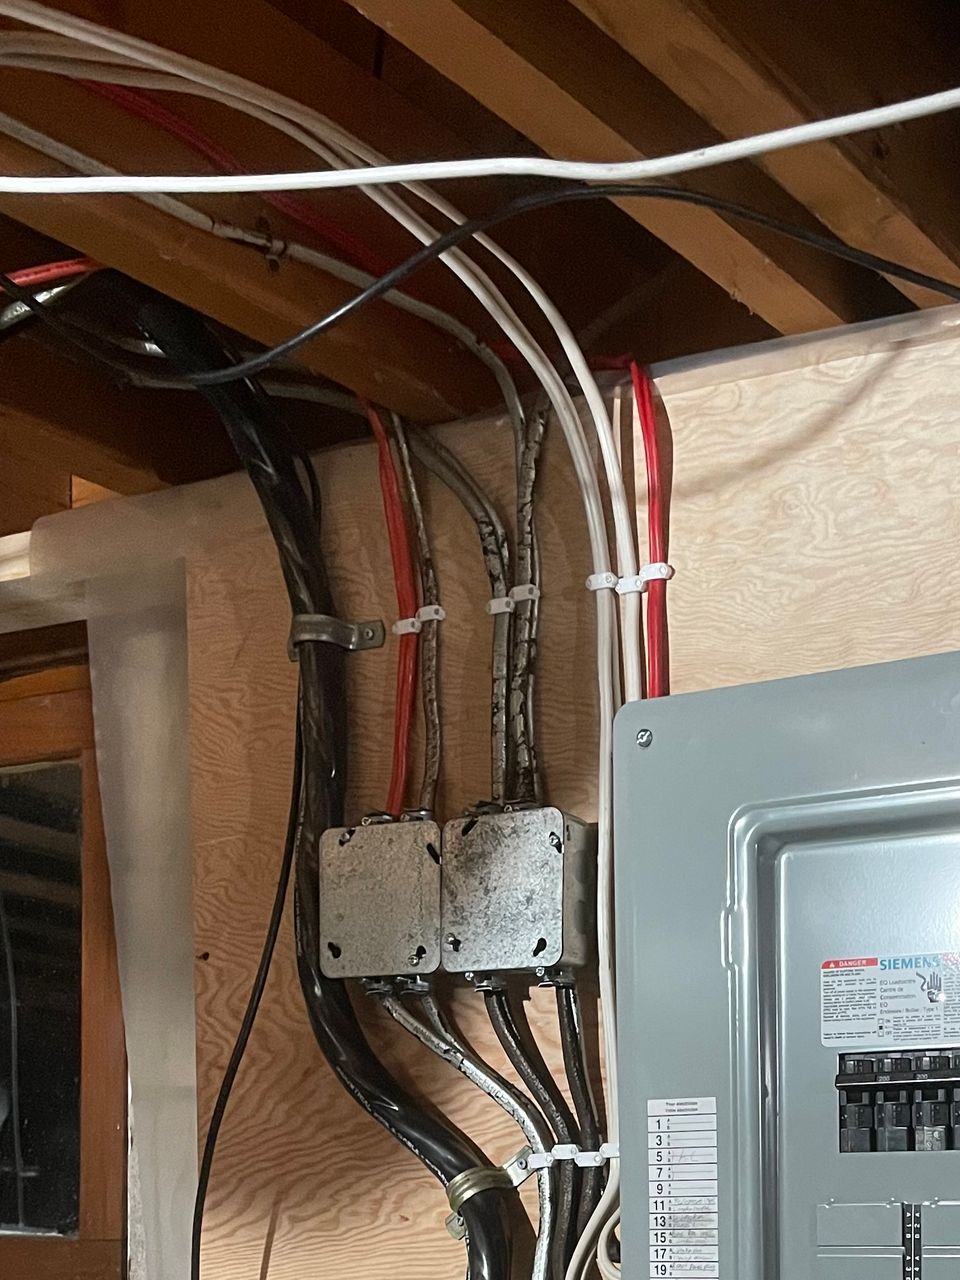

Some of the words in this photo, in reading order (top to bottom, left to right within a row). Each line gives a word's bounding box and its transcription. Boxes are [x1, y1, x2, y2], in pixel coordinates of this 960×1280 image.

[880, 956, 940, 970] SIEMENS
[654, 1118, 660, 1130] 1
[656, 1134, 662, 1146] 3
[656, 1152, 662, 1162] 5
[656, 1168, 662, 1178] 7
[656, 1182, 664, 1194] 9
[654, 1200, 664, 1210] 11
[654, 1216, 666, 1228] 13
[654, 1232, 666, 1244] 15
[654, 1248, 666, 1258] 17
[654, 1264, 666, 1276] 19
